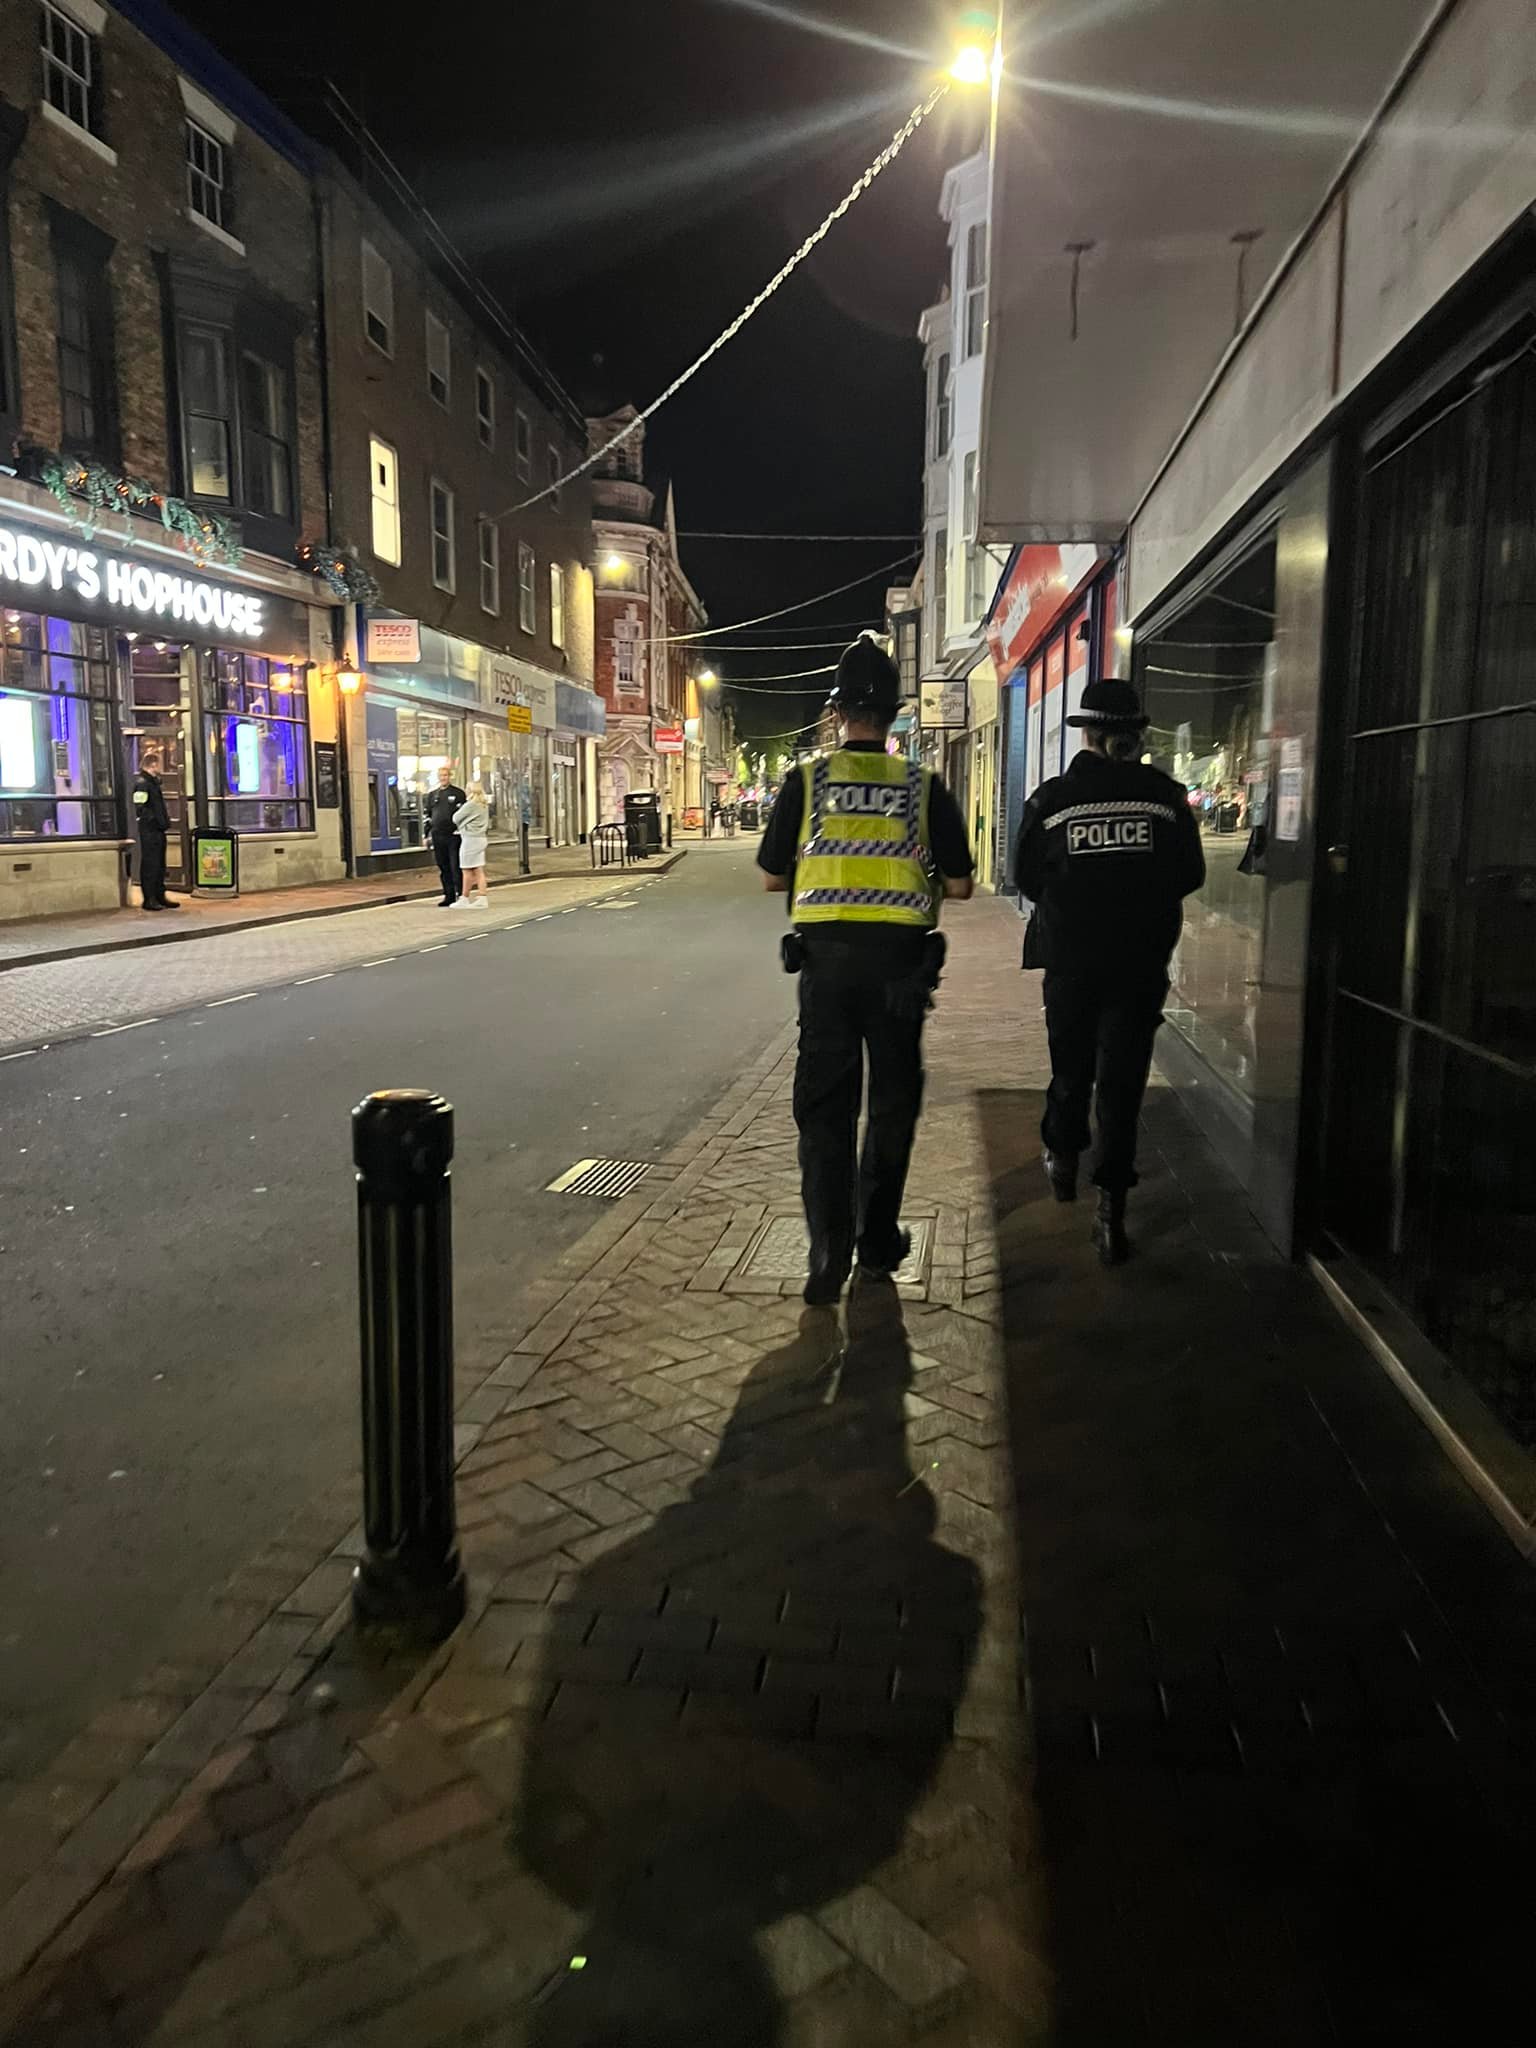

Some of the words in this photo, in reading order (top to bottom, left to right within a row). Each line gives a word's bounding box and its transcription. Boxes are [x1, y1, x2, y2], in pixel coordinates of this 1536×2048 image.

[107, 559, 264, 637] HOPHOUSE
[375, 624, 412, 633] TESCO
[828, 786, 908, 815] POLICE
[1072, 821, 1148, 849] POLICE
